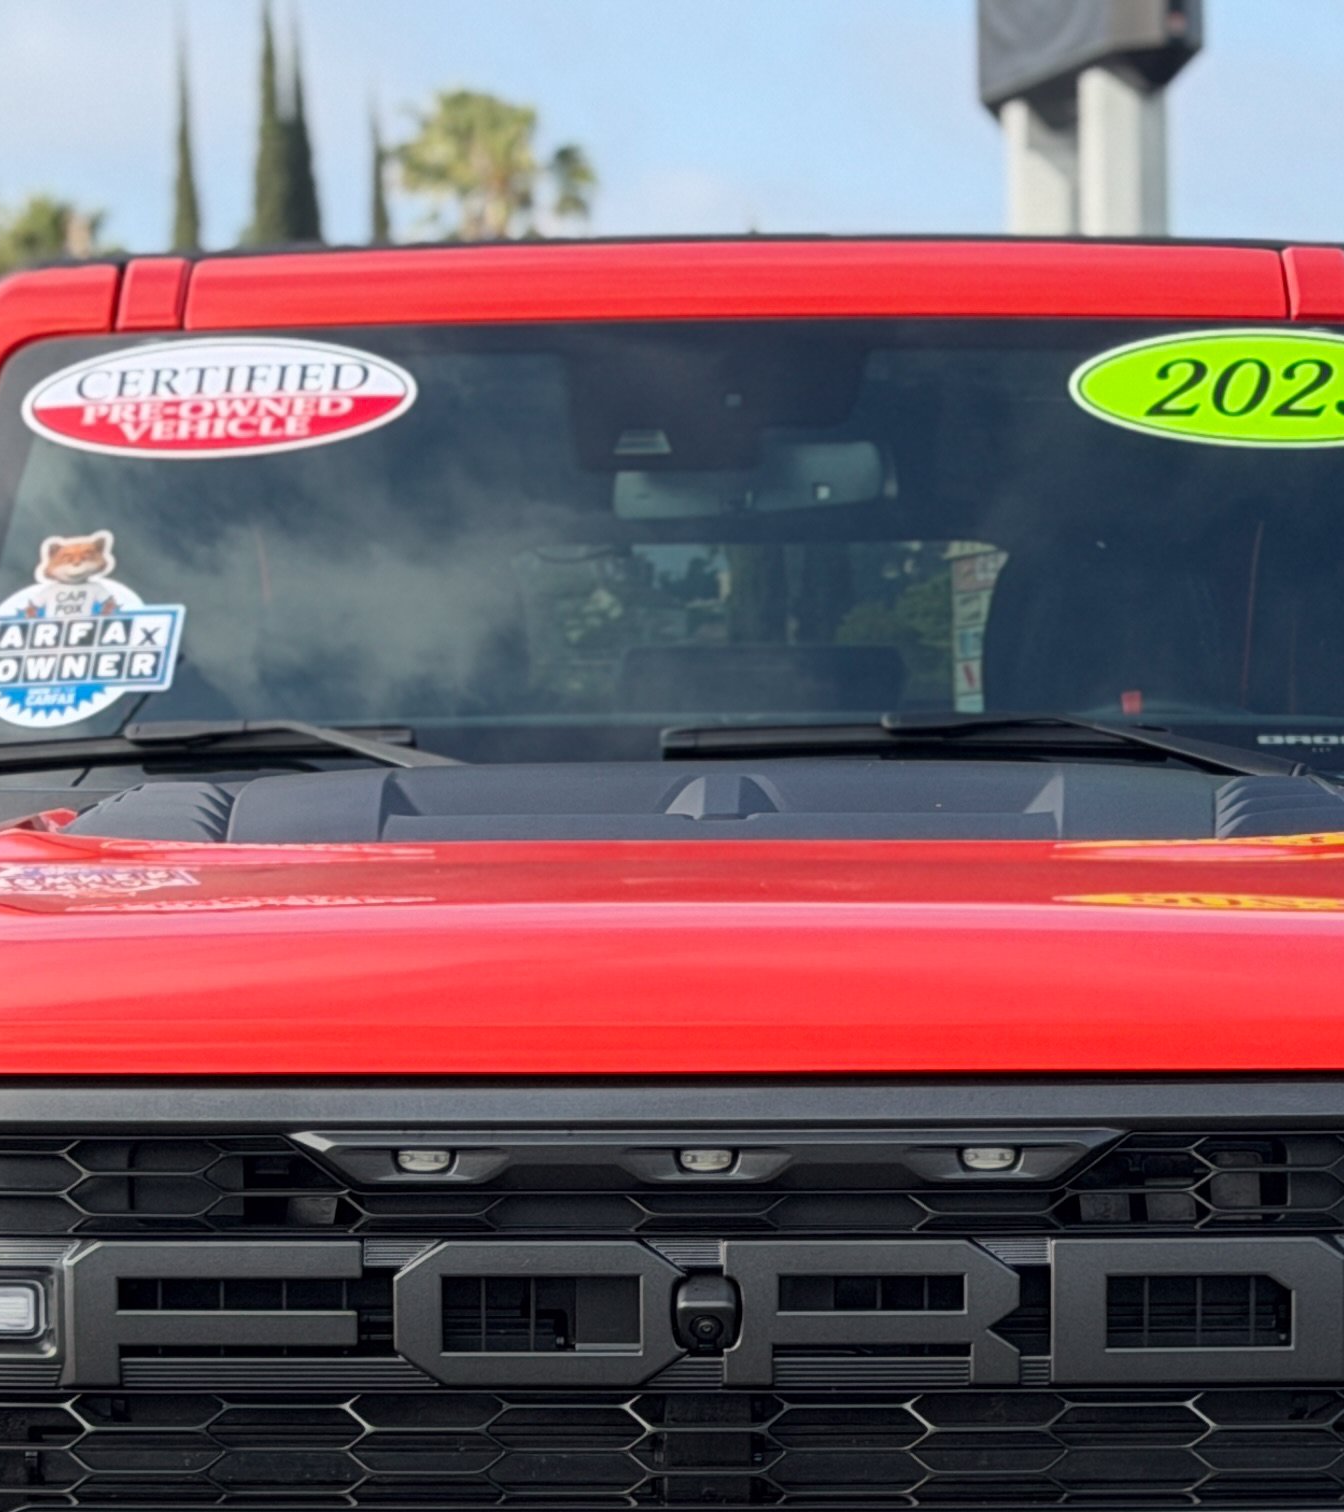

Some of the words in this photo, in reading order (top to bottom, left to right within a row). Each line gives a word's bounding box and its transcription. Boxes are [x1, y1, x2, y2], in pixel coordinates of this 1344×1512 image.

[76, 363, 370, 400] CERTIFIED
[81, 396, 354, 426] PRE-OWNED
[119, 415, 311, 442] VEHICLE
[56, 591, 87, 602] CAR
[56, 603, 83, 615] FOX
